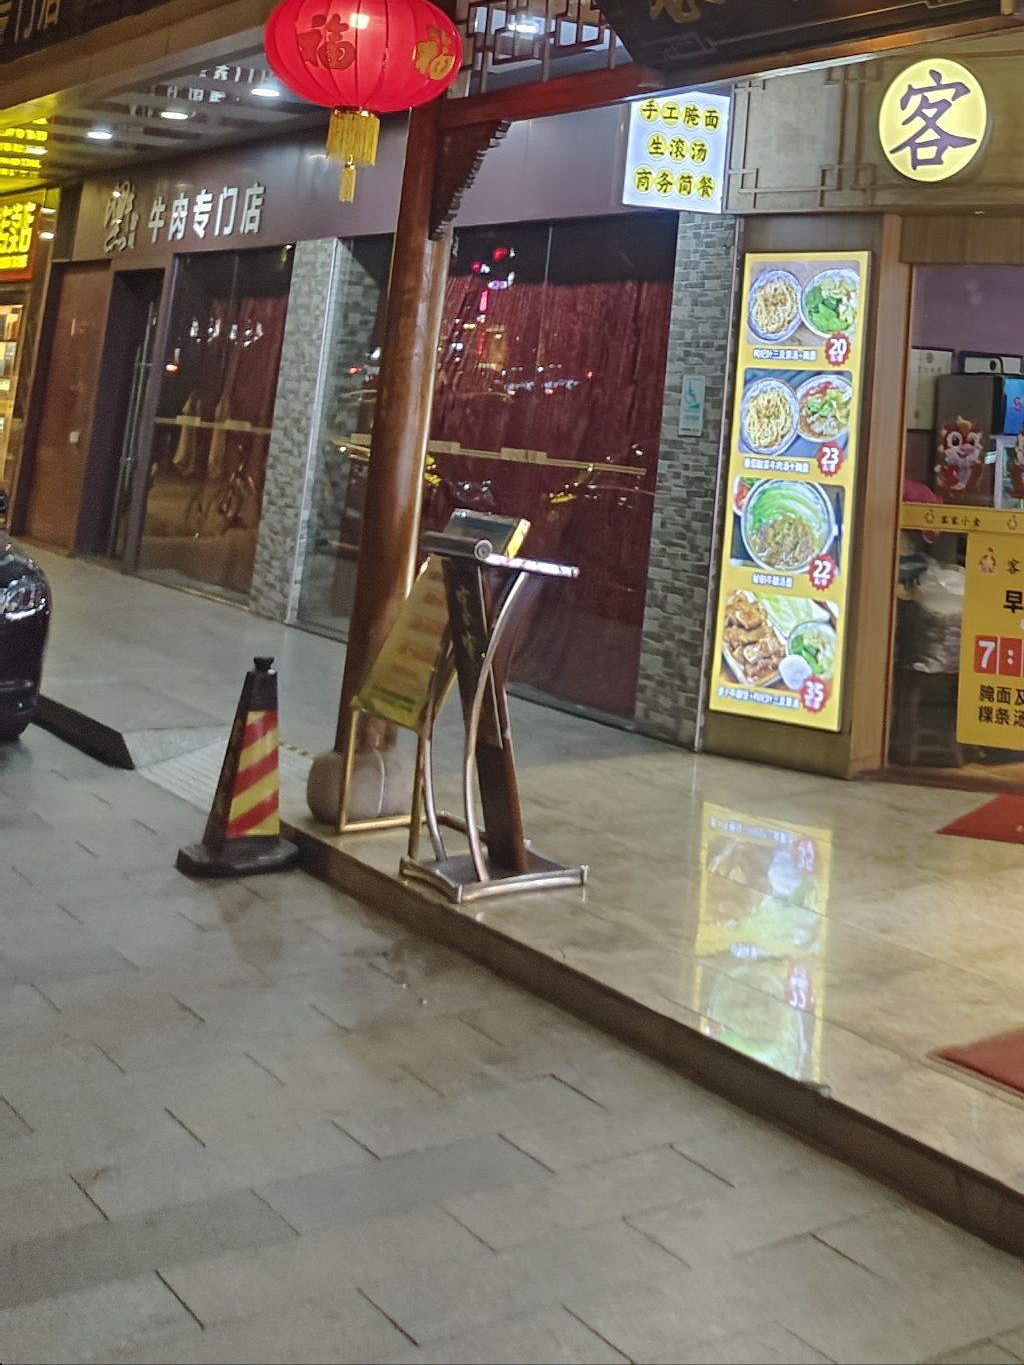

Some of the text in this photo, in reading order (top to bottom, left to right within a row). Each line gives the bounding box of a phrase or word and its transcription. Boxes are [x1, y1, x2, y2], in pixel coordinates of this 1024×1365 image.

[649, 136, 708, 162] 生滚汤
[148, 182, 265, 243] 牛肉专门店
[828, 338, 848, 355] 20
[821, 447, 839, 465] 23
[813, 560, 831, 579] 22
